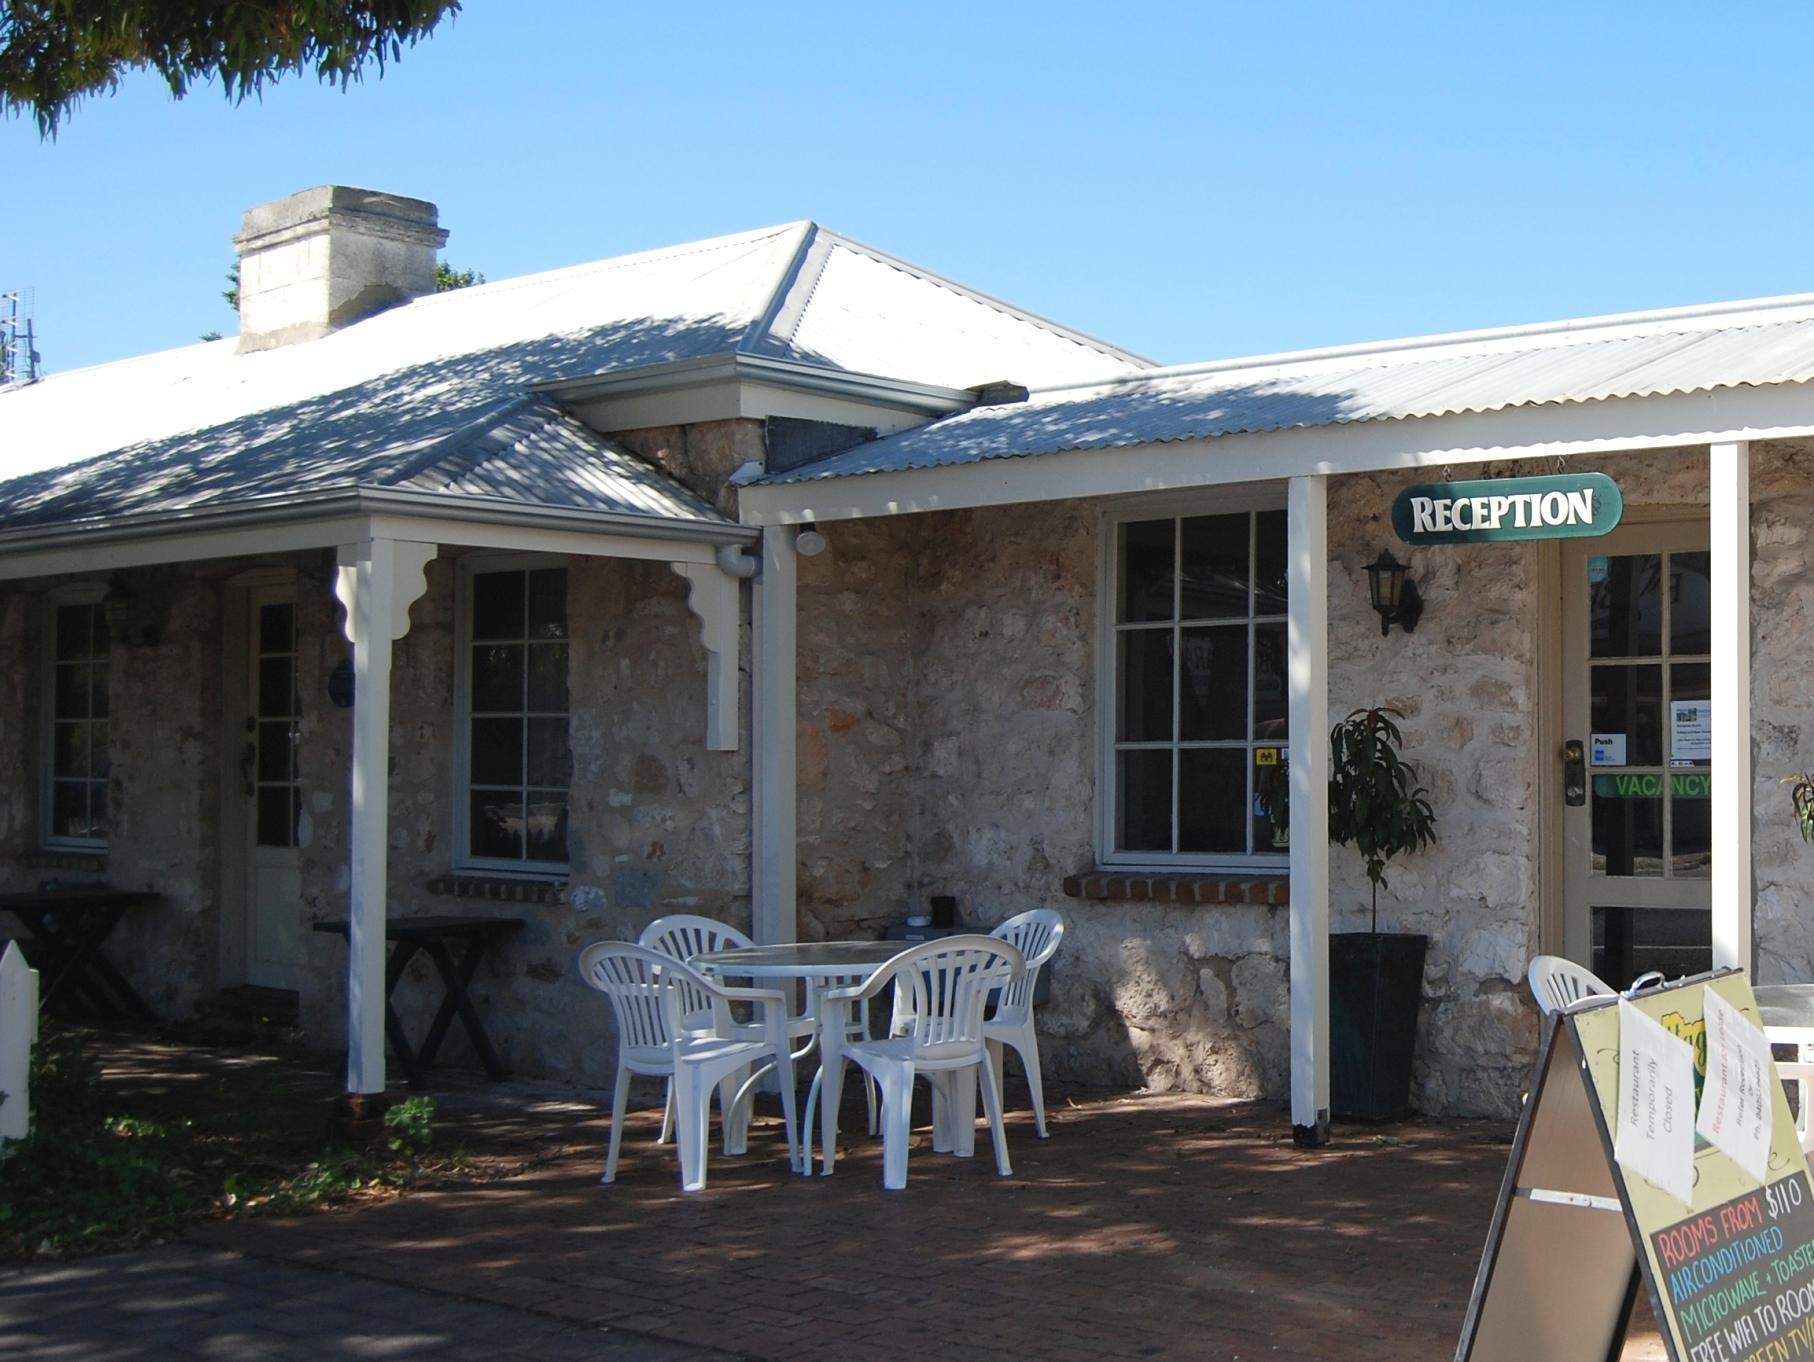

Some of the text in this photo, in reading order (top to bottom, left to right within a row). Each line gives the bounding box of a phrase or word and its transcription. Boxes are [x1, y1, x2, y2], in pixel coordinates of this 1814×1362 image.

[1410, 488, 1594, 533] RECEPTION
[1630, 1049, 1640, 1128] Restaurant
[1646, 1057, 1658, 1141] Temporarily
[1663, 1086, 1673, 1133] Closed
[1712, 1063, 1728, 1134] Restaurant
[1658, 1178, 1802, 1269] ROOMS FROM $110
[1670, 1226, 1784, 1306] AIRCONDITIONED
[1679, 1271, 1768, 1344] MICROWAVE
[1771, 1240, 1814, 1286] TOASTE
[1723, 1315, 1759, 1355] WIFI
[1754, 1304, 1778, 1337] TO
